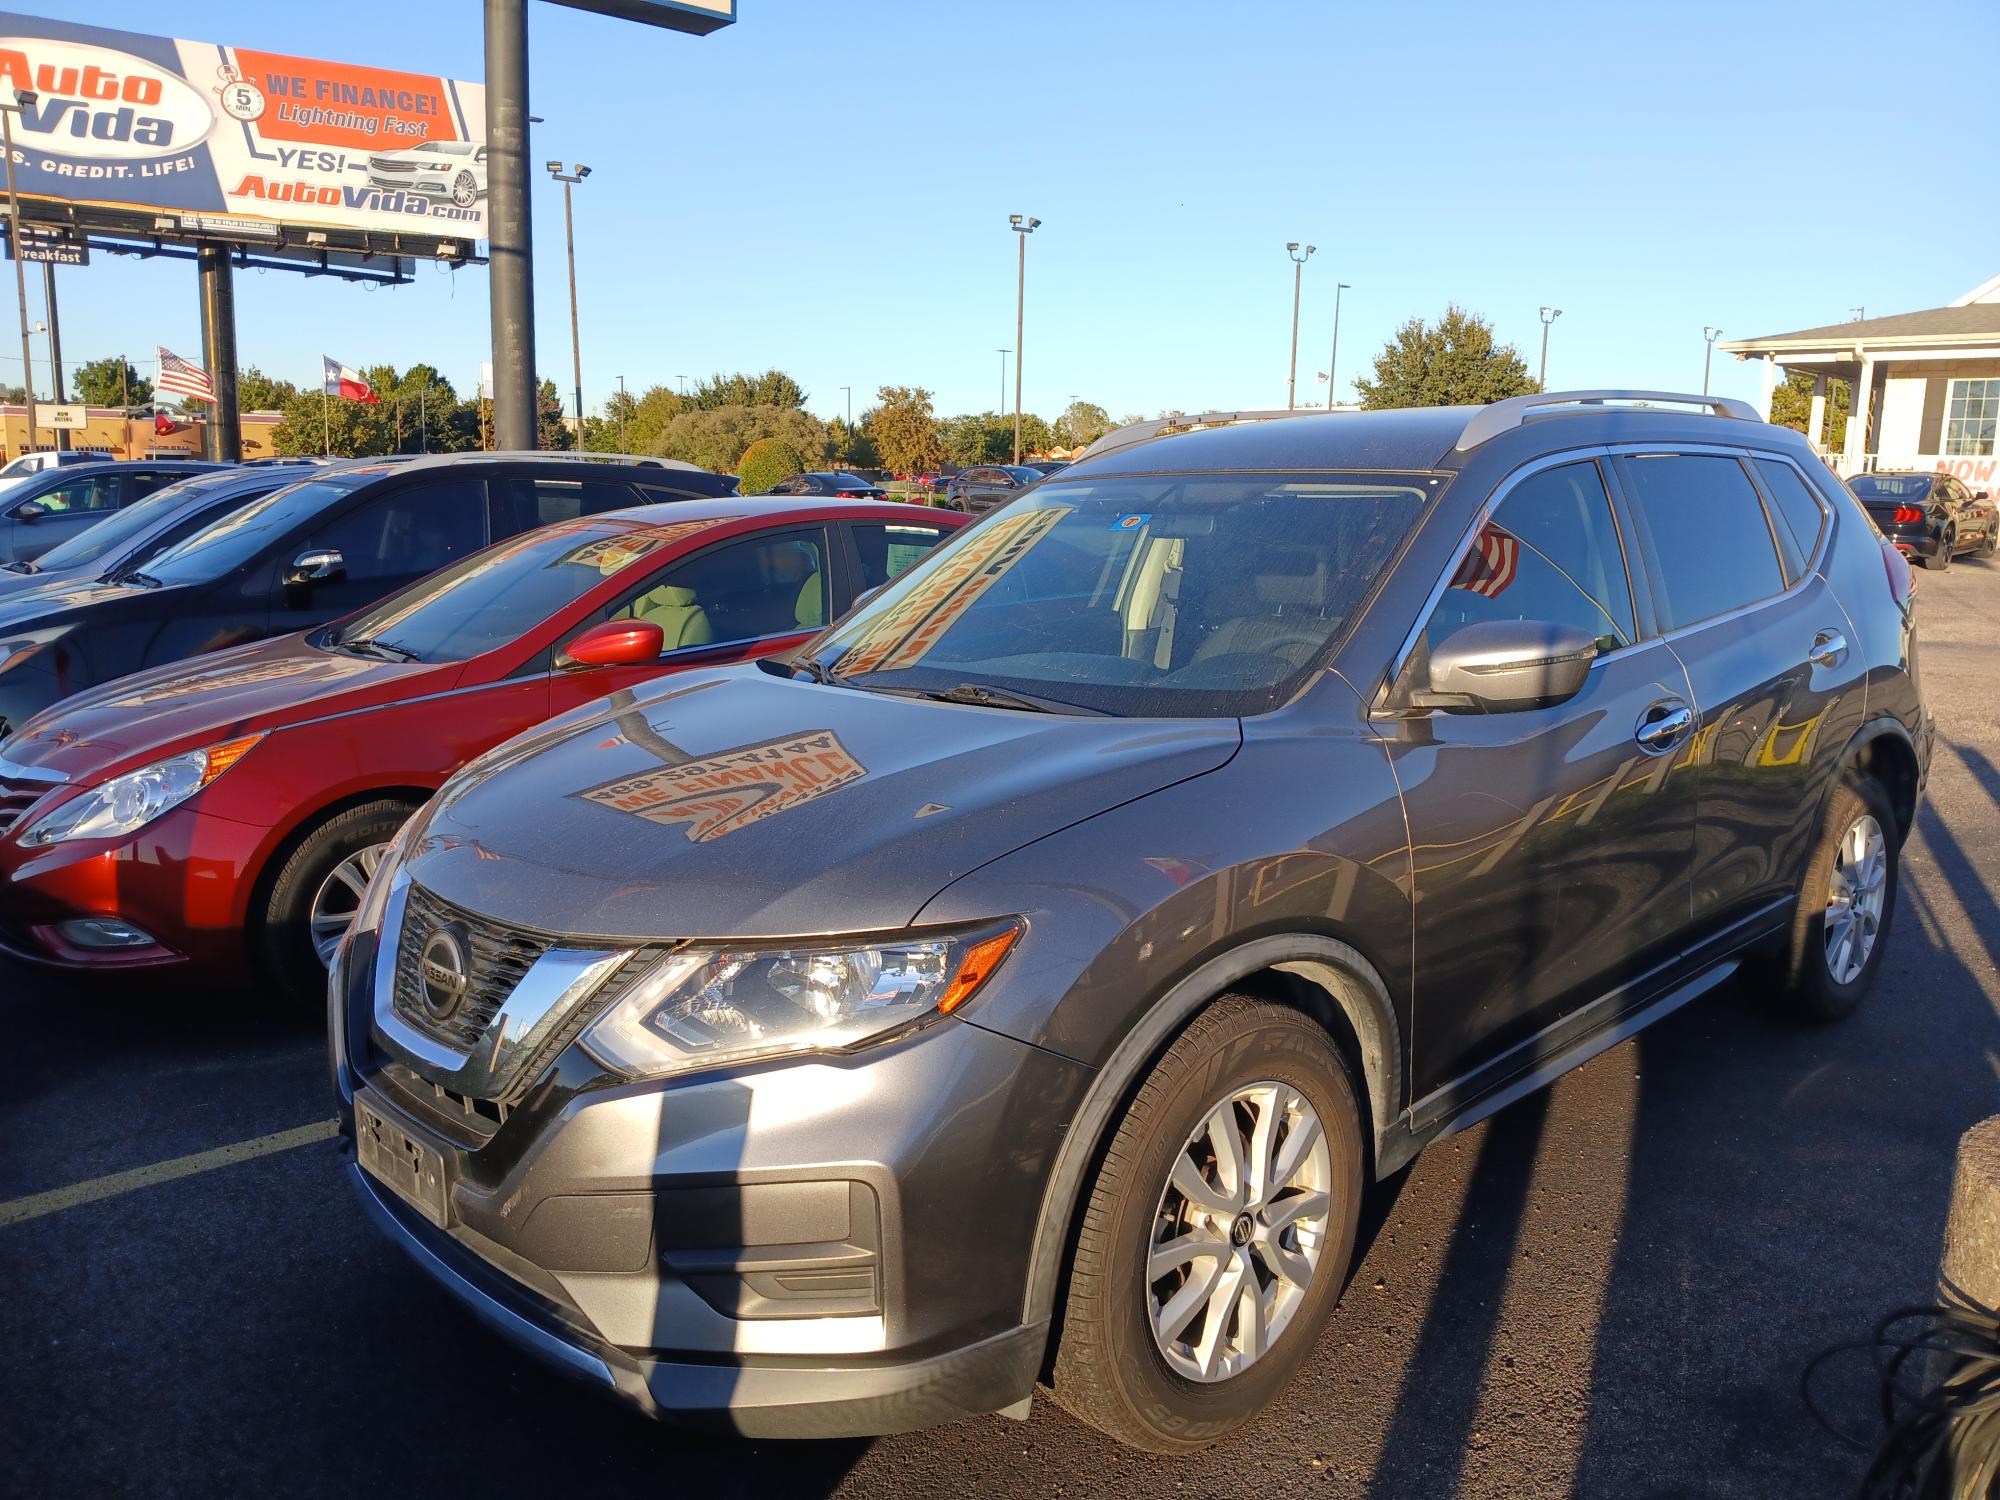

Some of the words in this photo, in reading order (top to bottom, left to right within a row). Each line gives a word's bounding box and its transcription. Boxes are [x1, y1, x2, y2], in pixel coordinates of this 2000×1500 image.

[0, 49, 163, 106] Auto
[236, 88, 252, 106] 5
[266, 74, 307, 98] WE
[315, 80, 438, 116] FINANCE!
[18, 97, 174, 147] Vida
[278, 102, 379, 136] Lightning
[383, 115, 429, 137] Fast
[41, 159, 134, 179] CREDIT.
[141, 156, 196, 178] LIFE!
[277, 147, 346, 173] YES!
[228, 174, 482, 223] AutoVida.com
[1936, 460, 1997, 482] NOW
[422, 961, 458, 989] NISSAN
